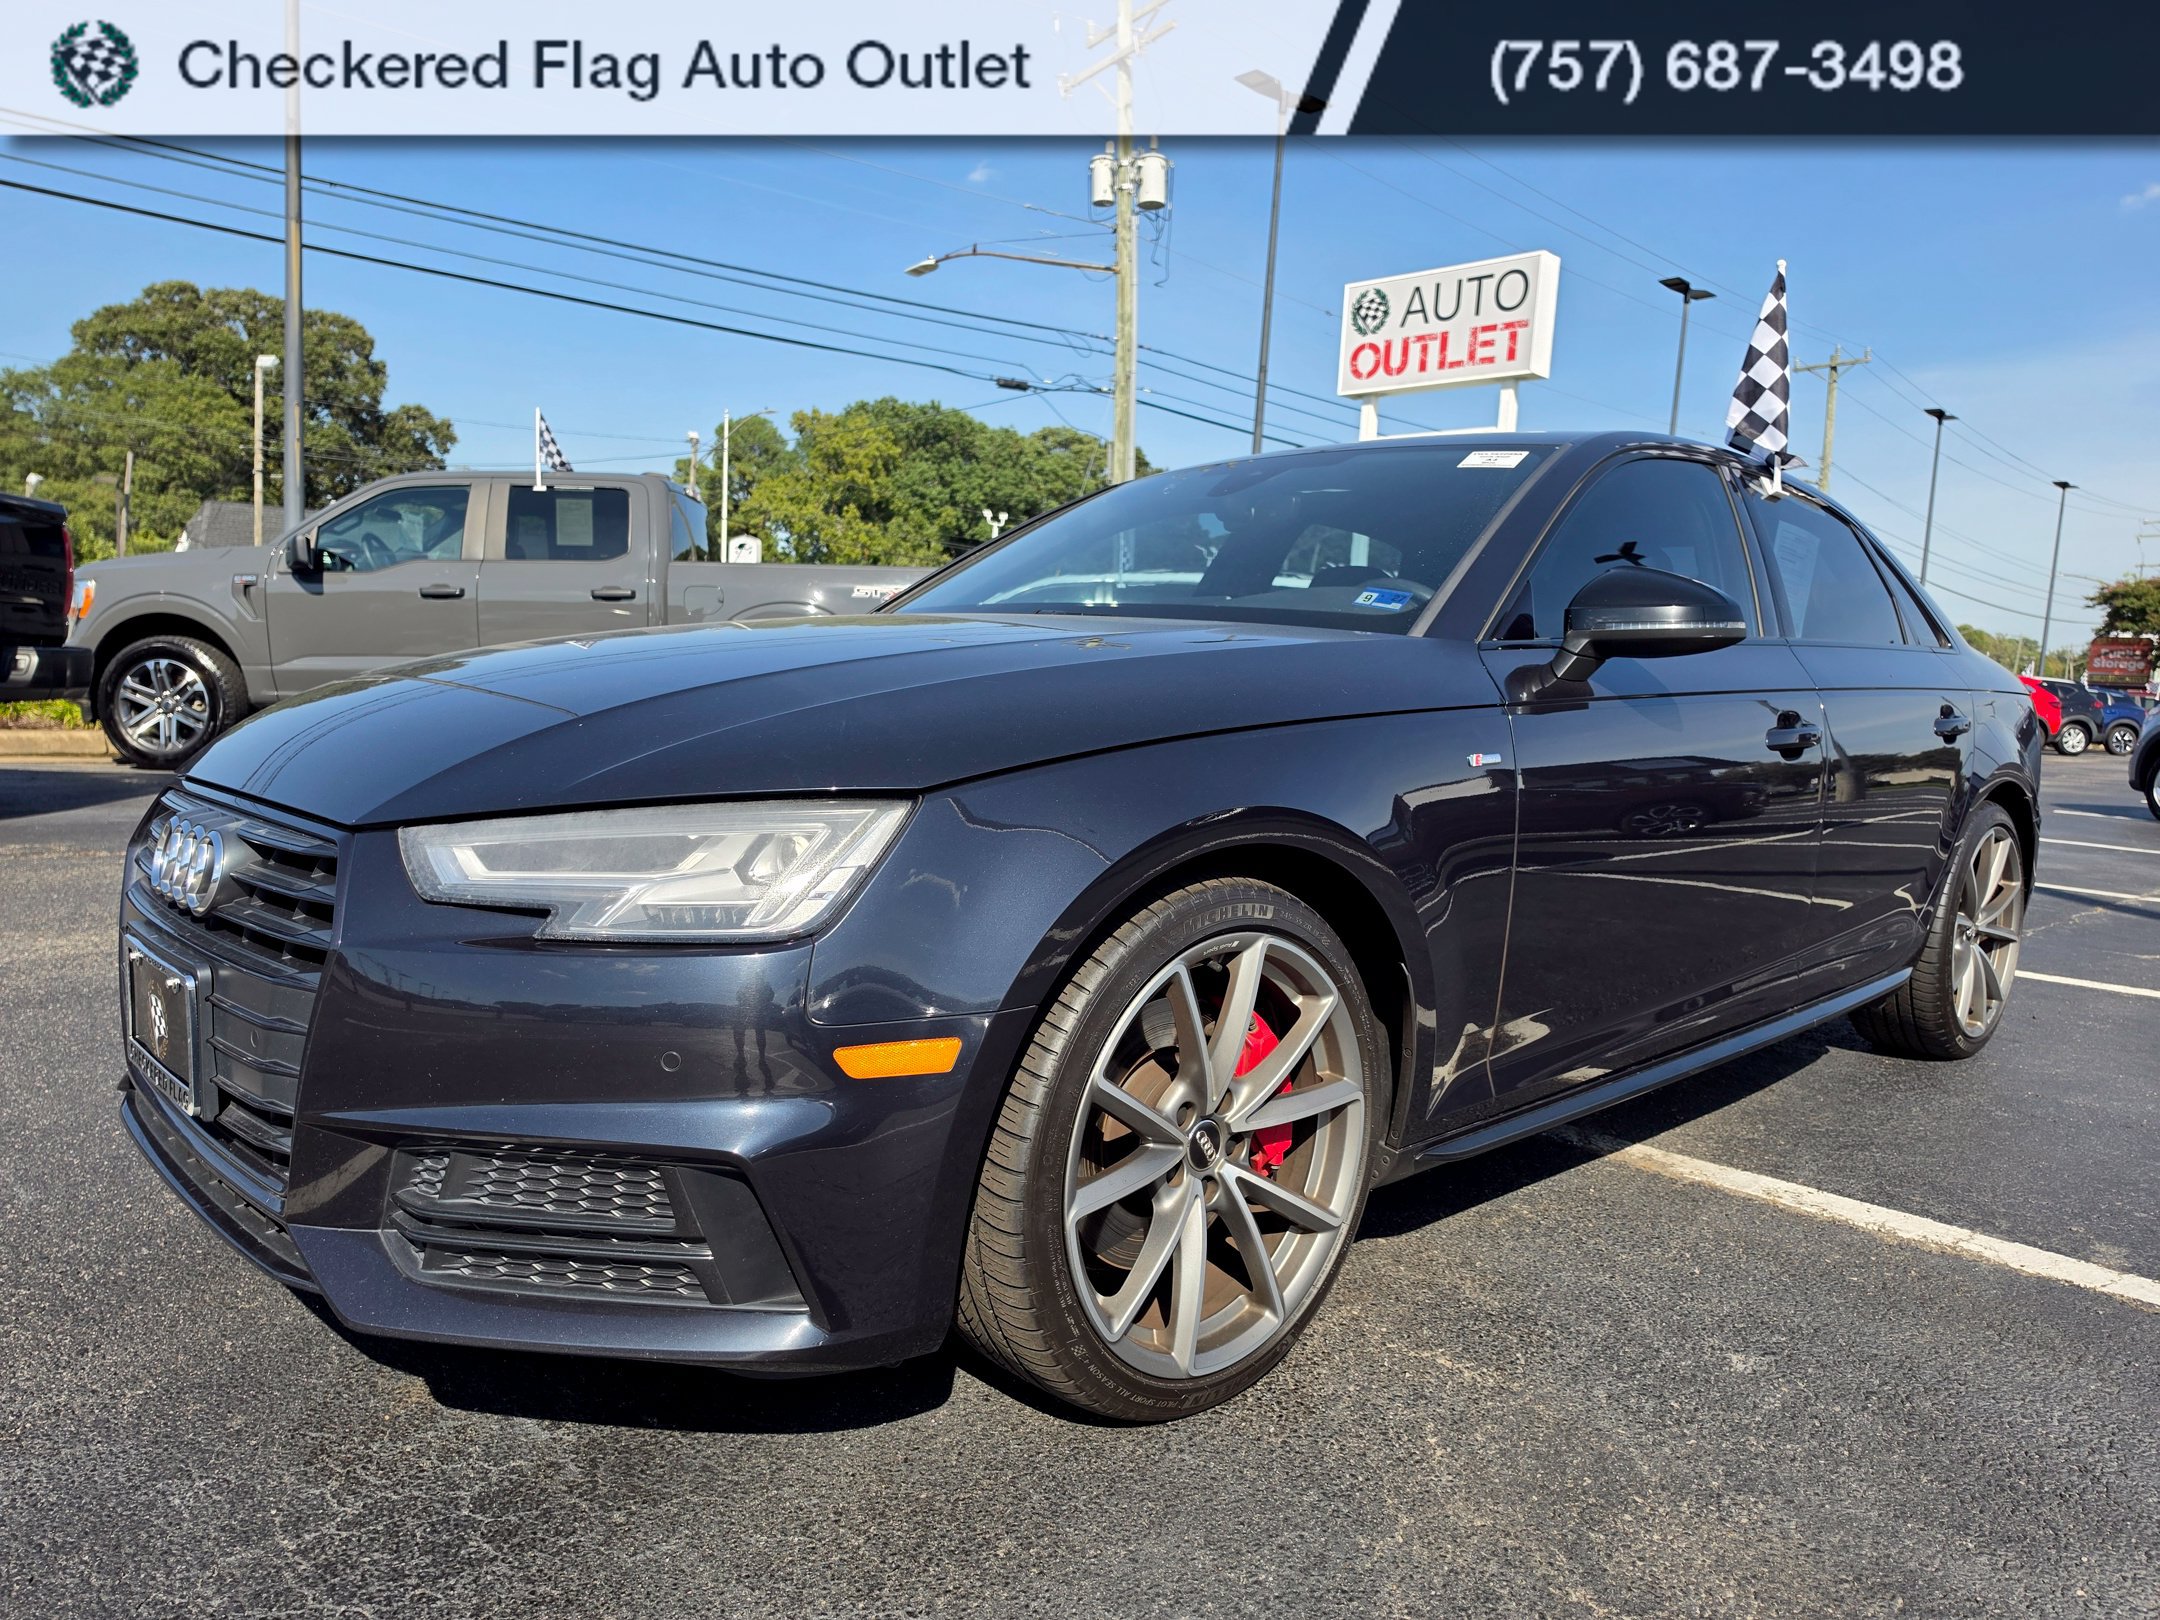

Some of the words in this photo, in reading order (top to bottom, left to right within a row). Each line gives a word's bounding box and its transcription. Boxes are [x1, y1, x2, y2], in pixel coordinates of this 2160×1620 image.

[1400, 269, 1529, 328] AUTO
[1350, 319, 1529, 380] OUTLET
[2092, 656, 2145, 672] Storage
[1183, 903, 1270, 935] MICHELIN
[1087, 1363, 1117, 1389] SEASON
[1115, 1386, 1131, 1397] ALL
[1130, 1394, 1156, 1406] SPORT
